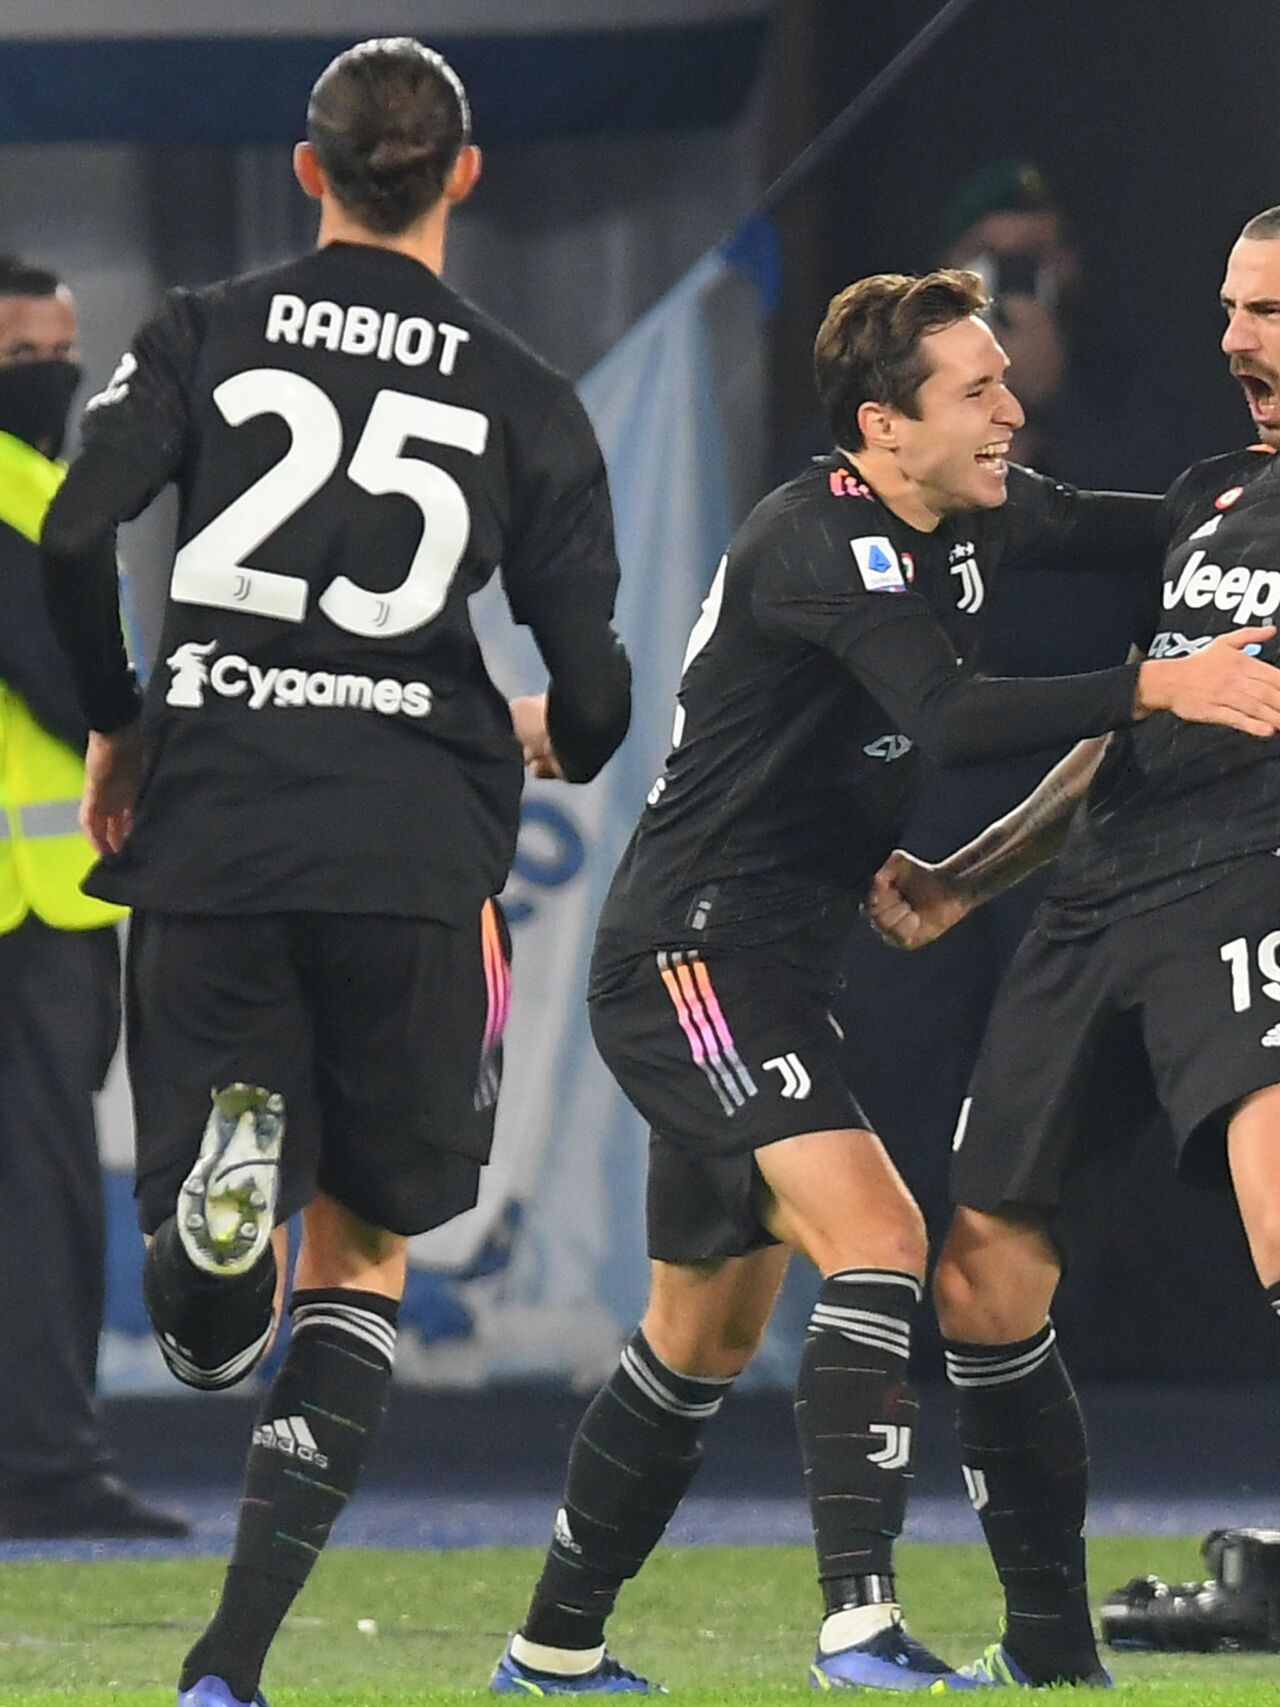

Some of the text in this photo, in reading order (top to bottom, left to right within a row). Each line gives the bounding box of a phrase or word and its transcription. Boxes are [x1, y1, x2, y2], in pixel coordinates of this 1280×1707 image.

[265, 293, 471, 376] RABIOT
[170, 368, 489, 639] 25
[210, 655, 433, 718] Cygames
